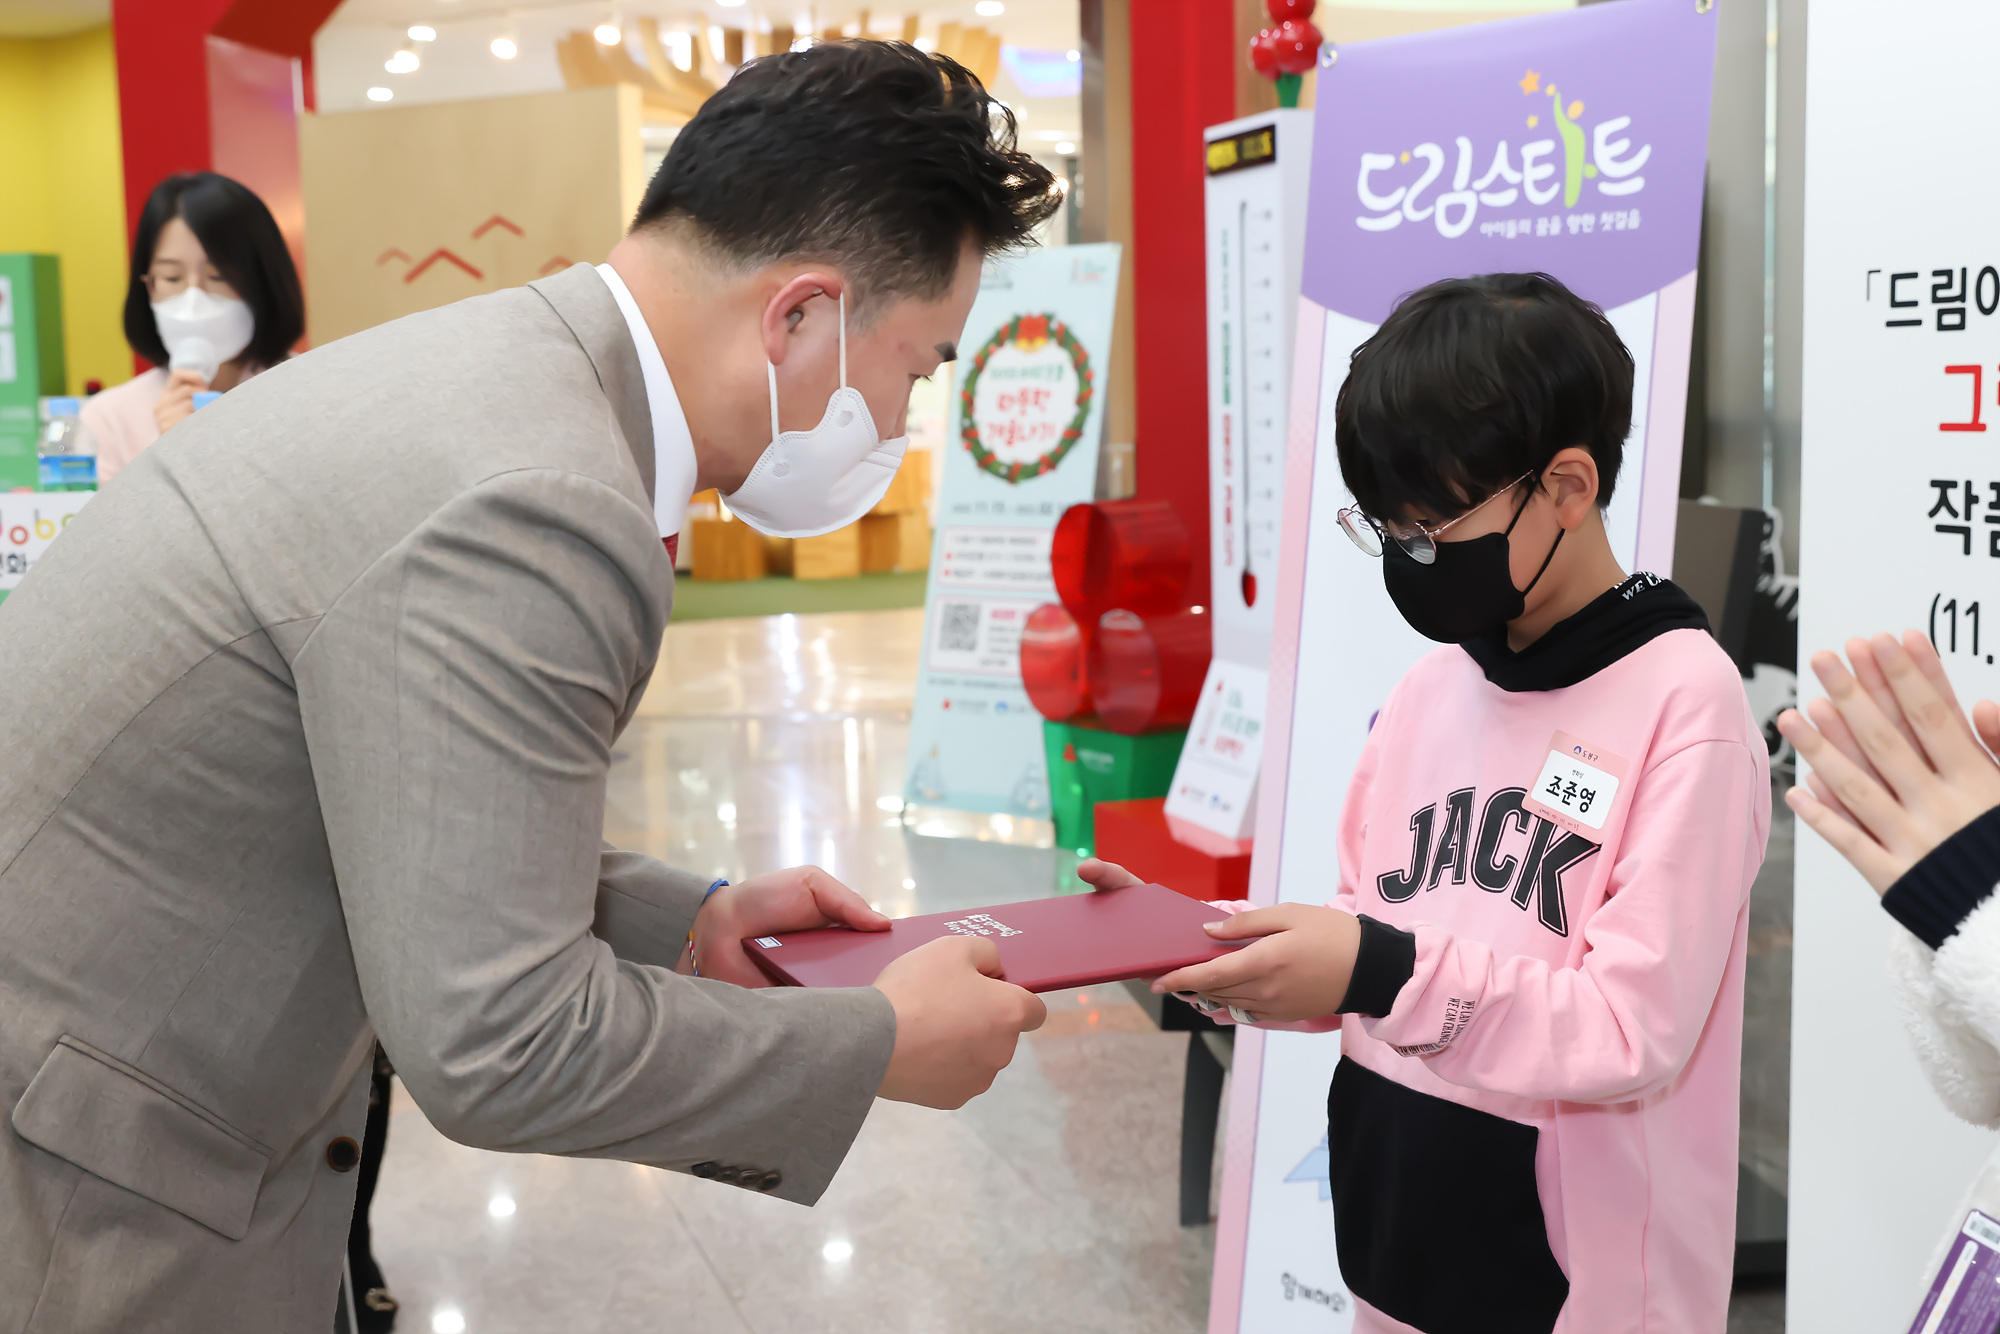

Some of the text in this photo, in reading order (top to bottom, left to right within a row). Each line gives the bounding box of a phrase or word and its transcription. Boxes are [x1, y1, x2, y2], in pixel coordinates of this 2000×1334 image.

[1355, 92, 1652, 239] 드림스타트
[1567, 213, 1596, 235] 향한
[1939, 364, 2000, 432] 그
[1622, 580, 1645, 600] WE
[1582, 750, 1599, 762] 도봉구
[1546, 775, 1596, 813] 조준영
[1377, 786, 1602, 938] JACK
